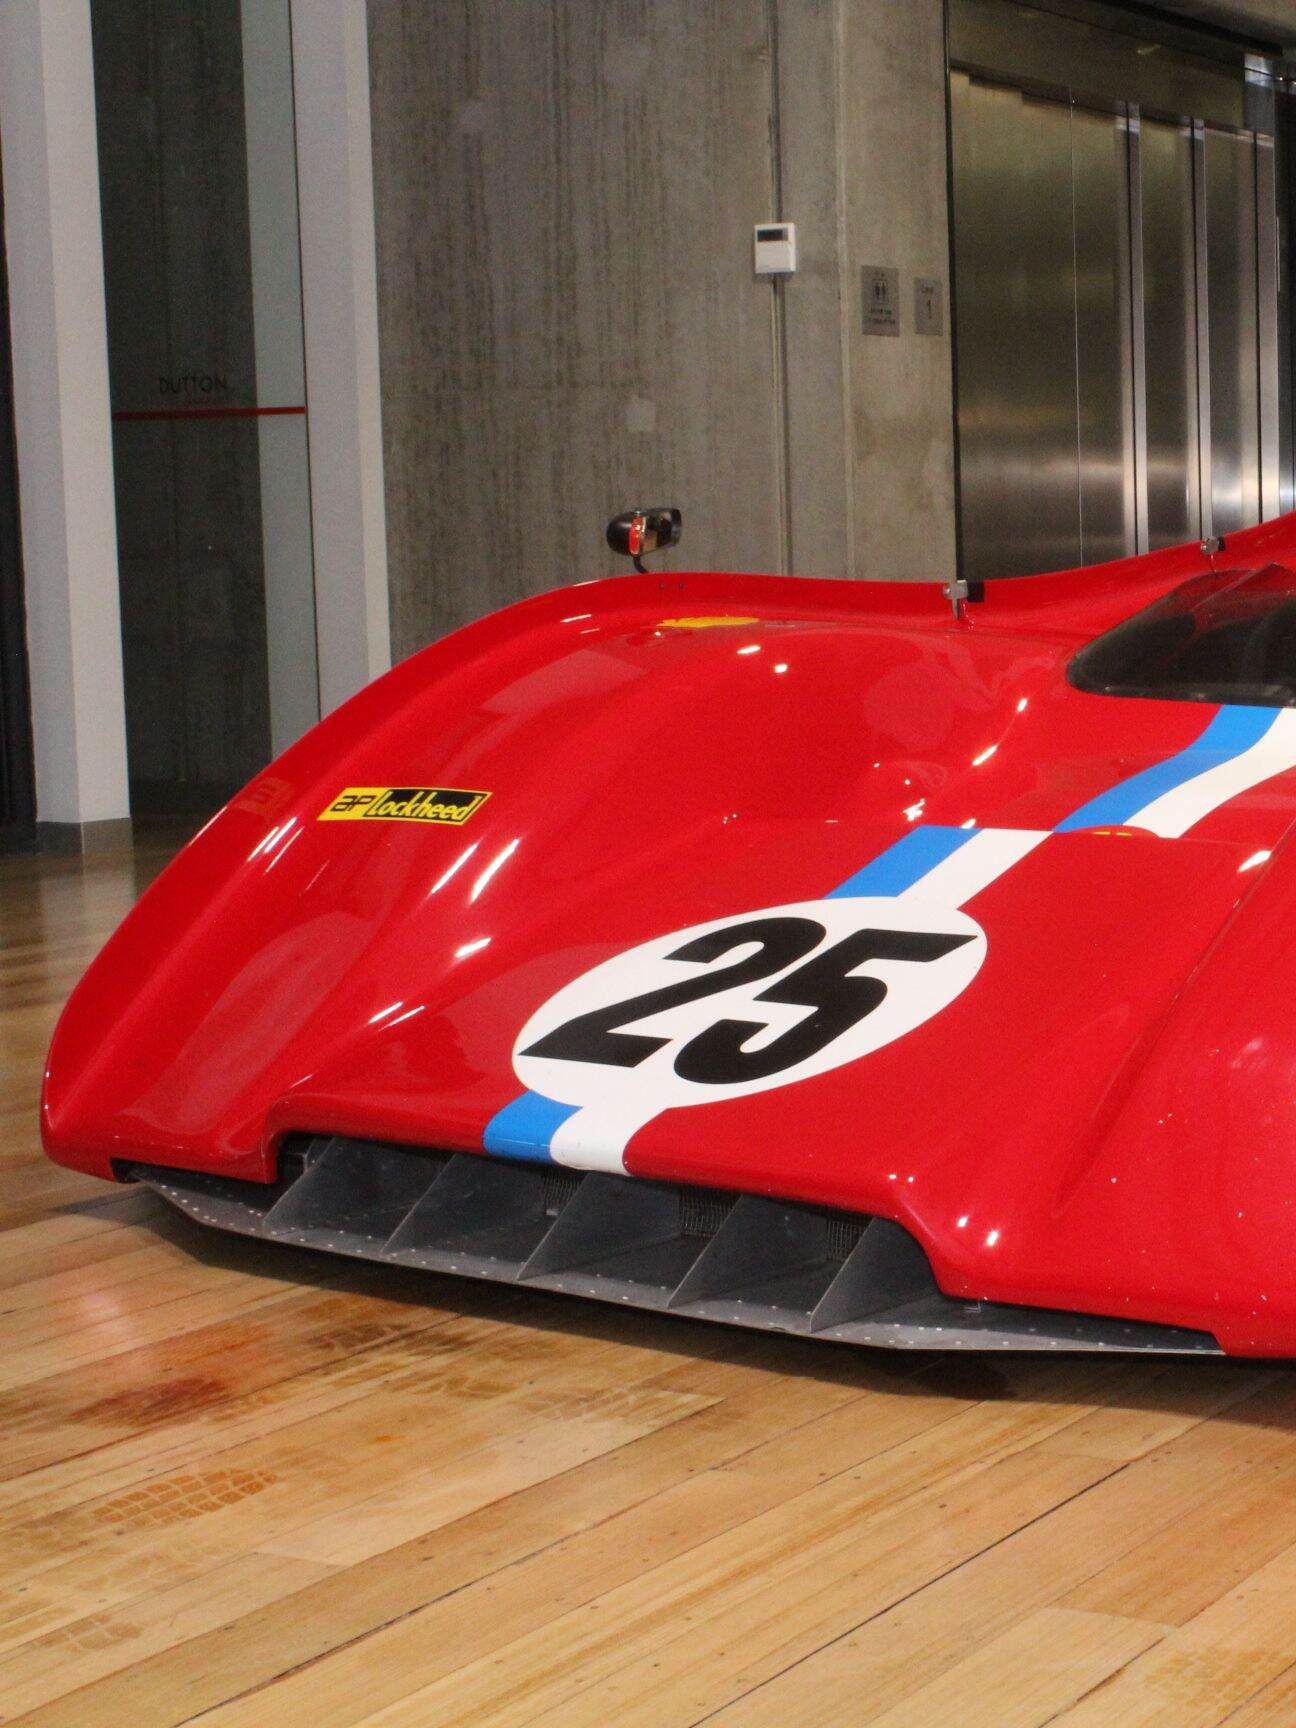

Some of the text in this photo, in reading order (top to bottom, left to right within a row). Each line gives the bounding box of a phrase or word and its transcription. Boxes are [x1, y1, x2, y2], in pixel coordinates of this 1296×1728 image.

[158, 375, 229, 394] DUTTON
[368, 791, 483, 820] Lockheed
[518, 916, 979, 1085] 25
